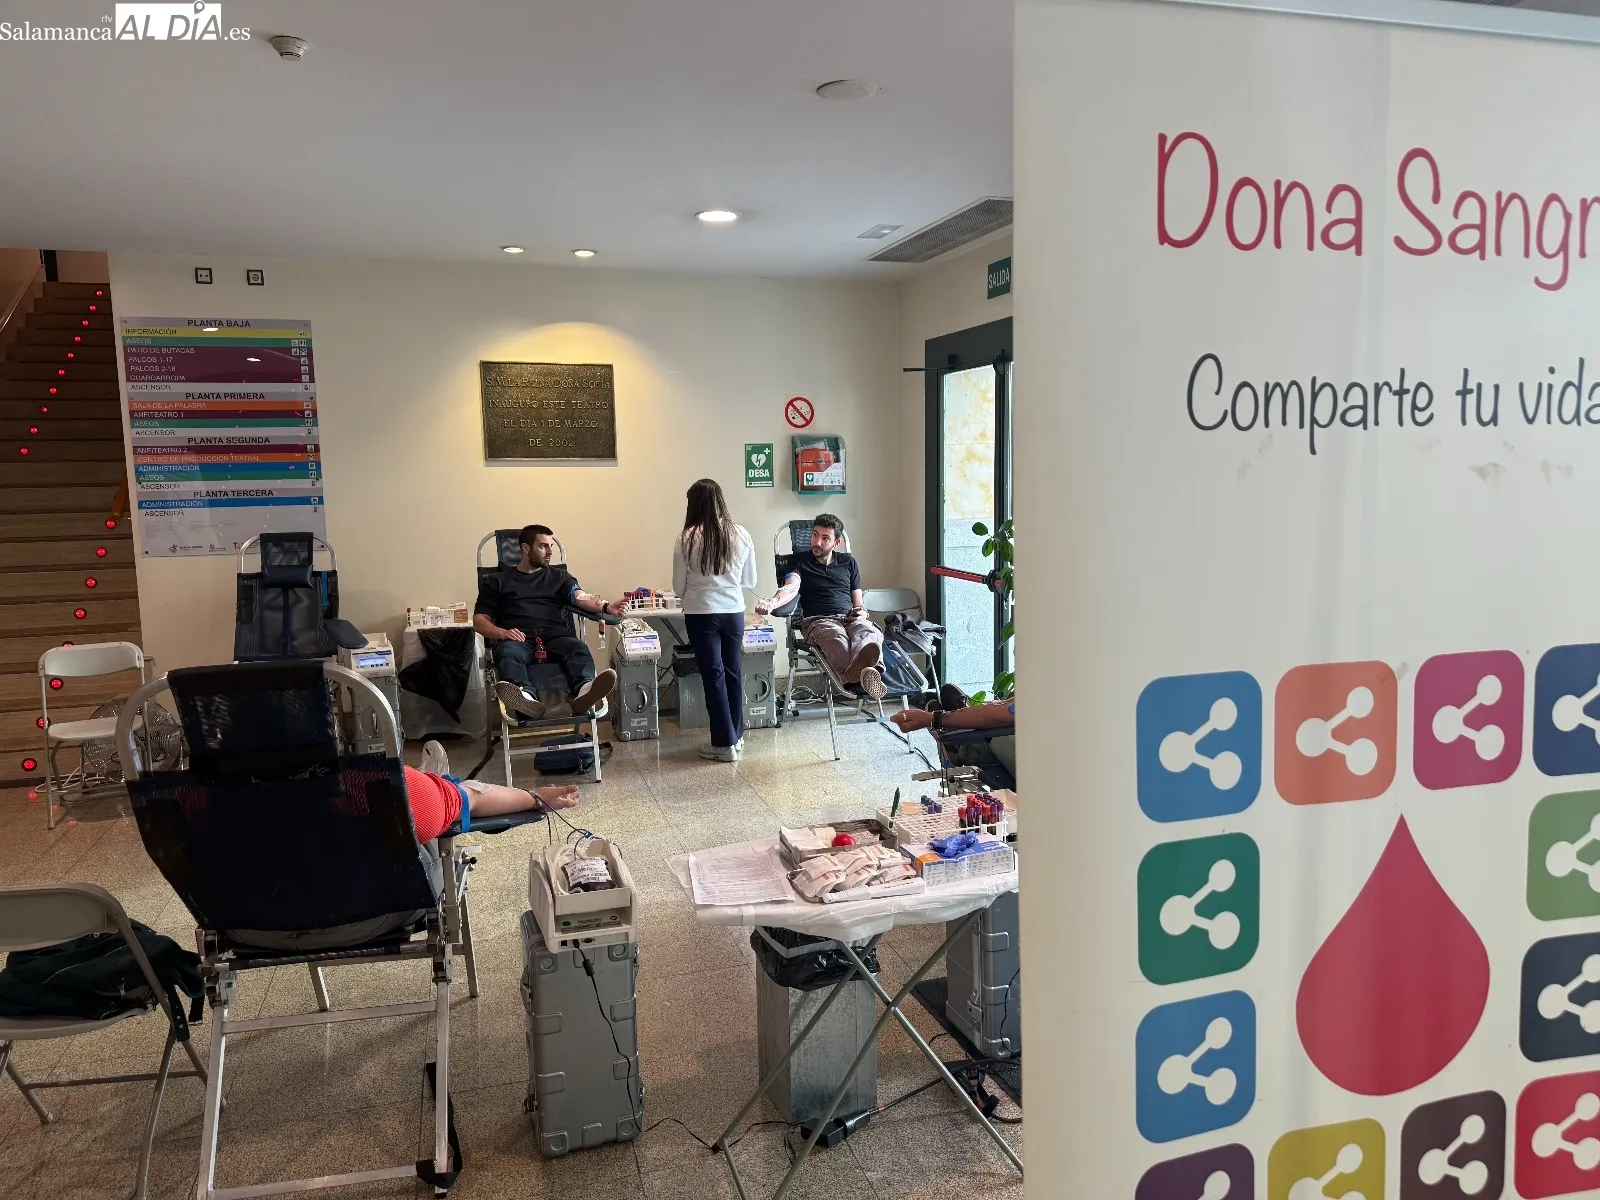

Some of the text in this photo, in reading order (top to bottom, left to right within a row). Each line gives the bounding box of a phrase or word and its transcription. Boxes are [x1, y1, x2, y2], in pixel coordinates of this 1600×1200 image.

[1157, 131, 1600, 291] Dona Sangr
[988, 268, 1010, 290] SALIDA
[187, 319, 251, 328] PLANTA BAJA
[185, 392, 266, 400] PLANTA PRIMERA
[542, 400, 566, 409] ESTE
[571, 400, 609, 409] TEATRO
[1186, 352, 1600, 455] Comparte tu vida
[503, 419, 517, 428] EL
[547, 419, 561, 428] DE
[563, 419, 598, 428] MARZO
[187, 436, 271, 445] PLANTA SEGUNDA
[528, 438, 574, 447] DE 2002
[231, 454, 261, 462] TEATRAL
[749, 468, 770, 478] DESA
[193, 489, 274, 498] PLANTA TERCERA
